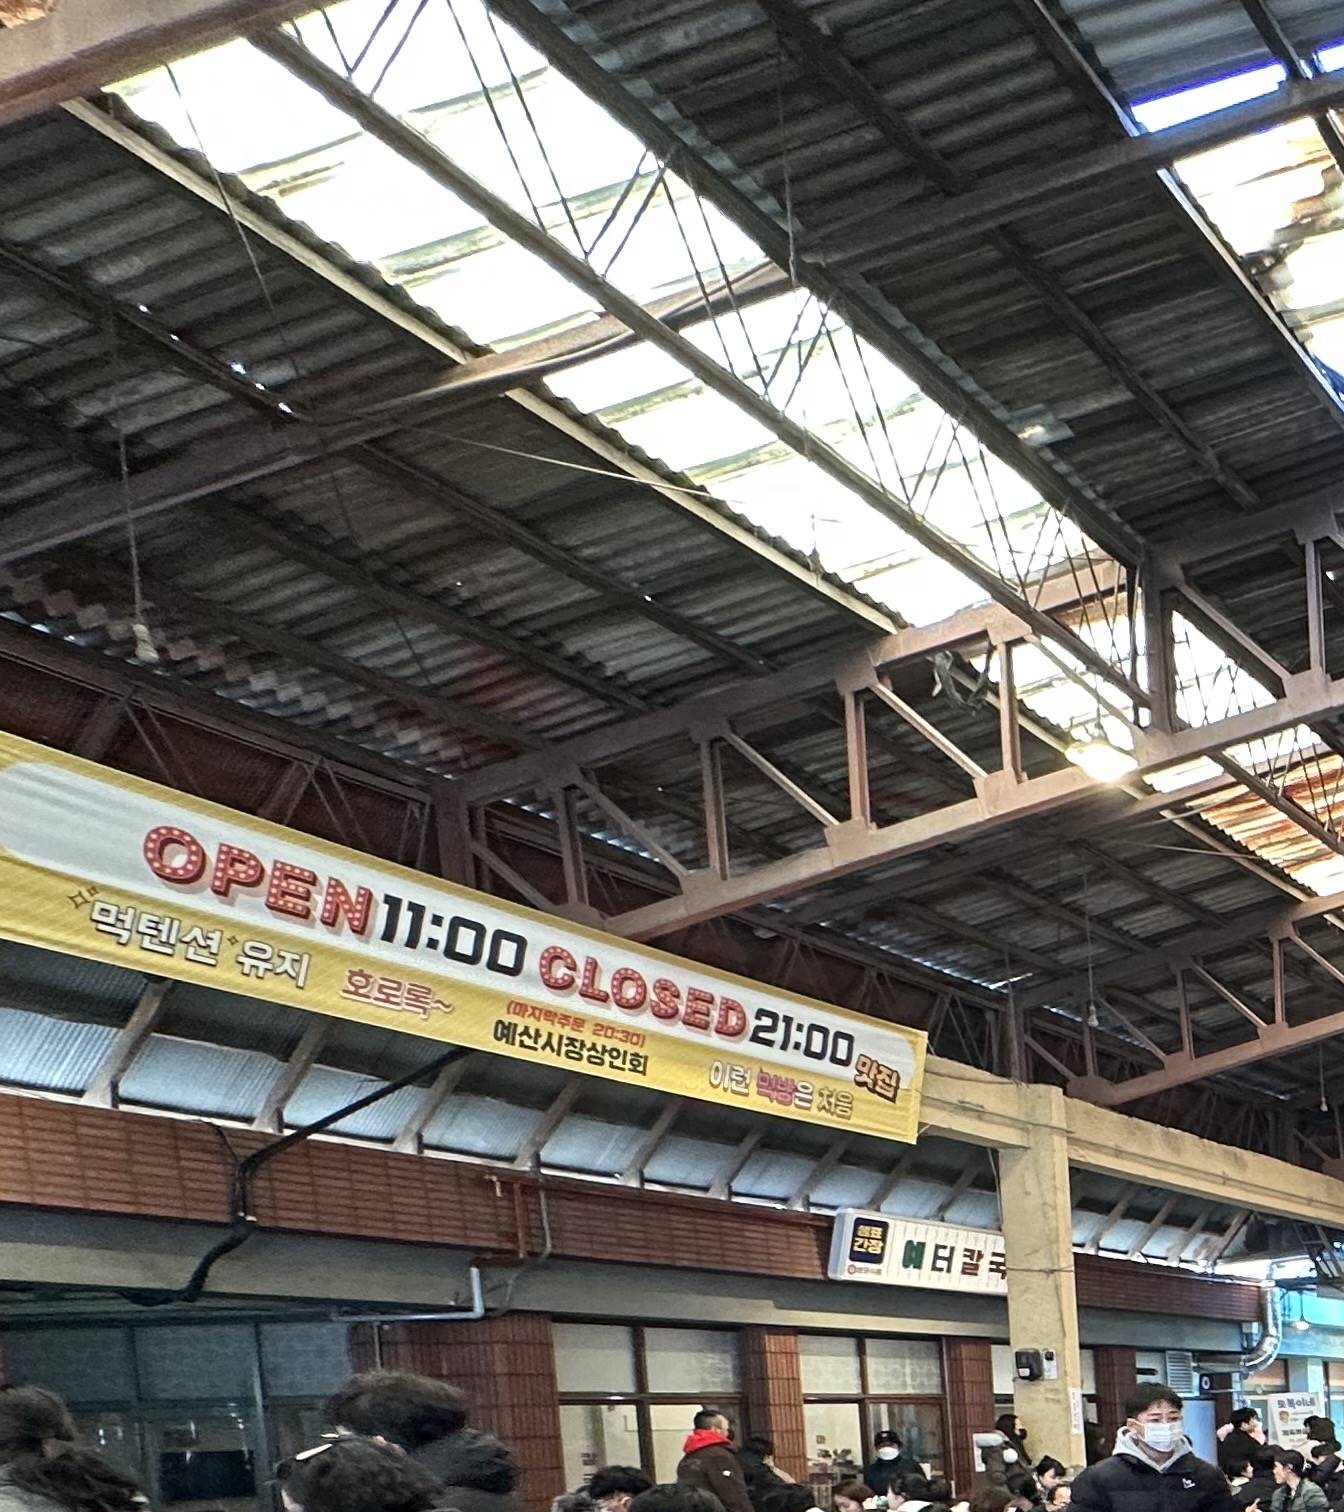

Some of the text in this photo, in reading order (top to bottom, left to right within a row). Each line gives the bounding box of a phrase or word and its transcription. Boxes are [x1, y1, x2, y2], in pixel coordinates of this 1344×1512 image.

[89, 900, 311, 990] 먹텐션 유지
[143, 825, 856, 1068] OPEN 11:00 CLOSED 21:00
[492, 1019, 649, 1077] 예산시장상인회
[505, 999, 647, 1049] (마지막주문 20:30)
[709, 1060, 854, 1120] 이런 먹방은 처음
[853, 1053, 901, 1103] 맛집
[853, 1238, 884, 1255] 간장
